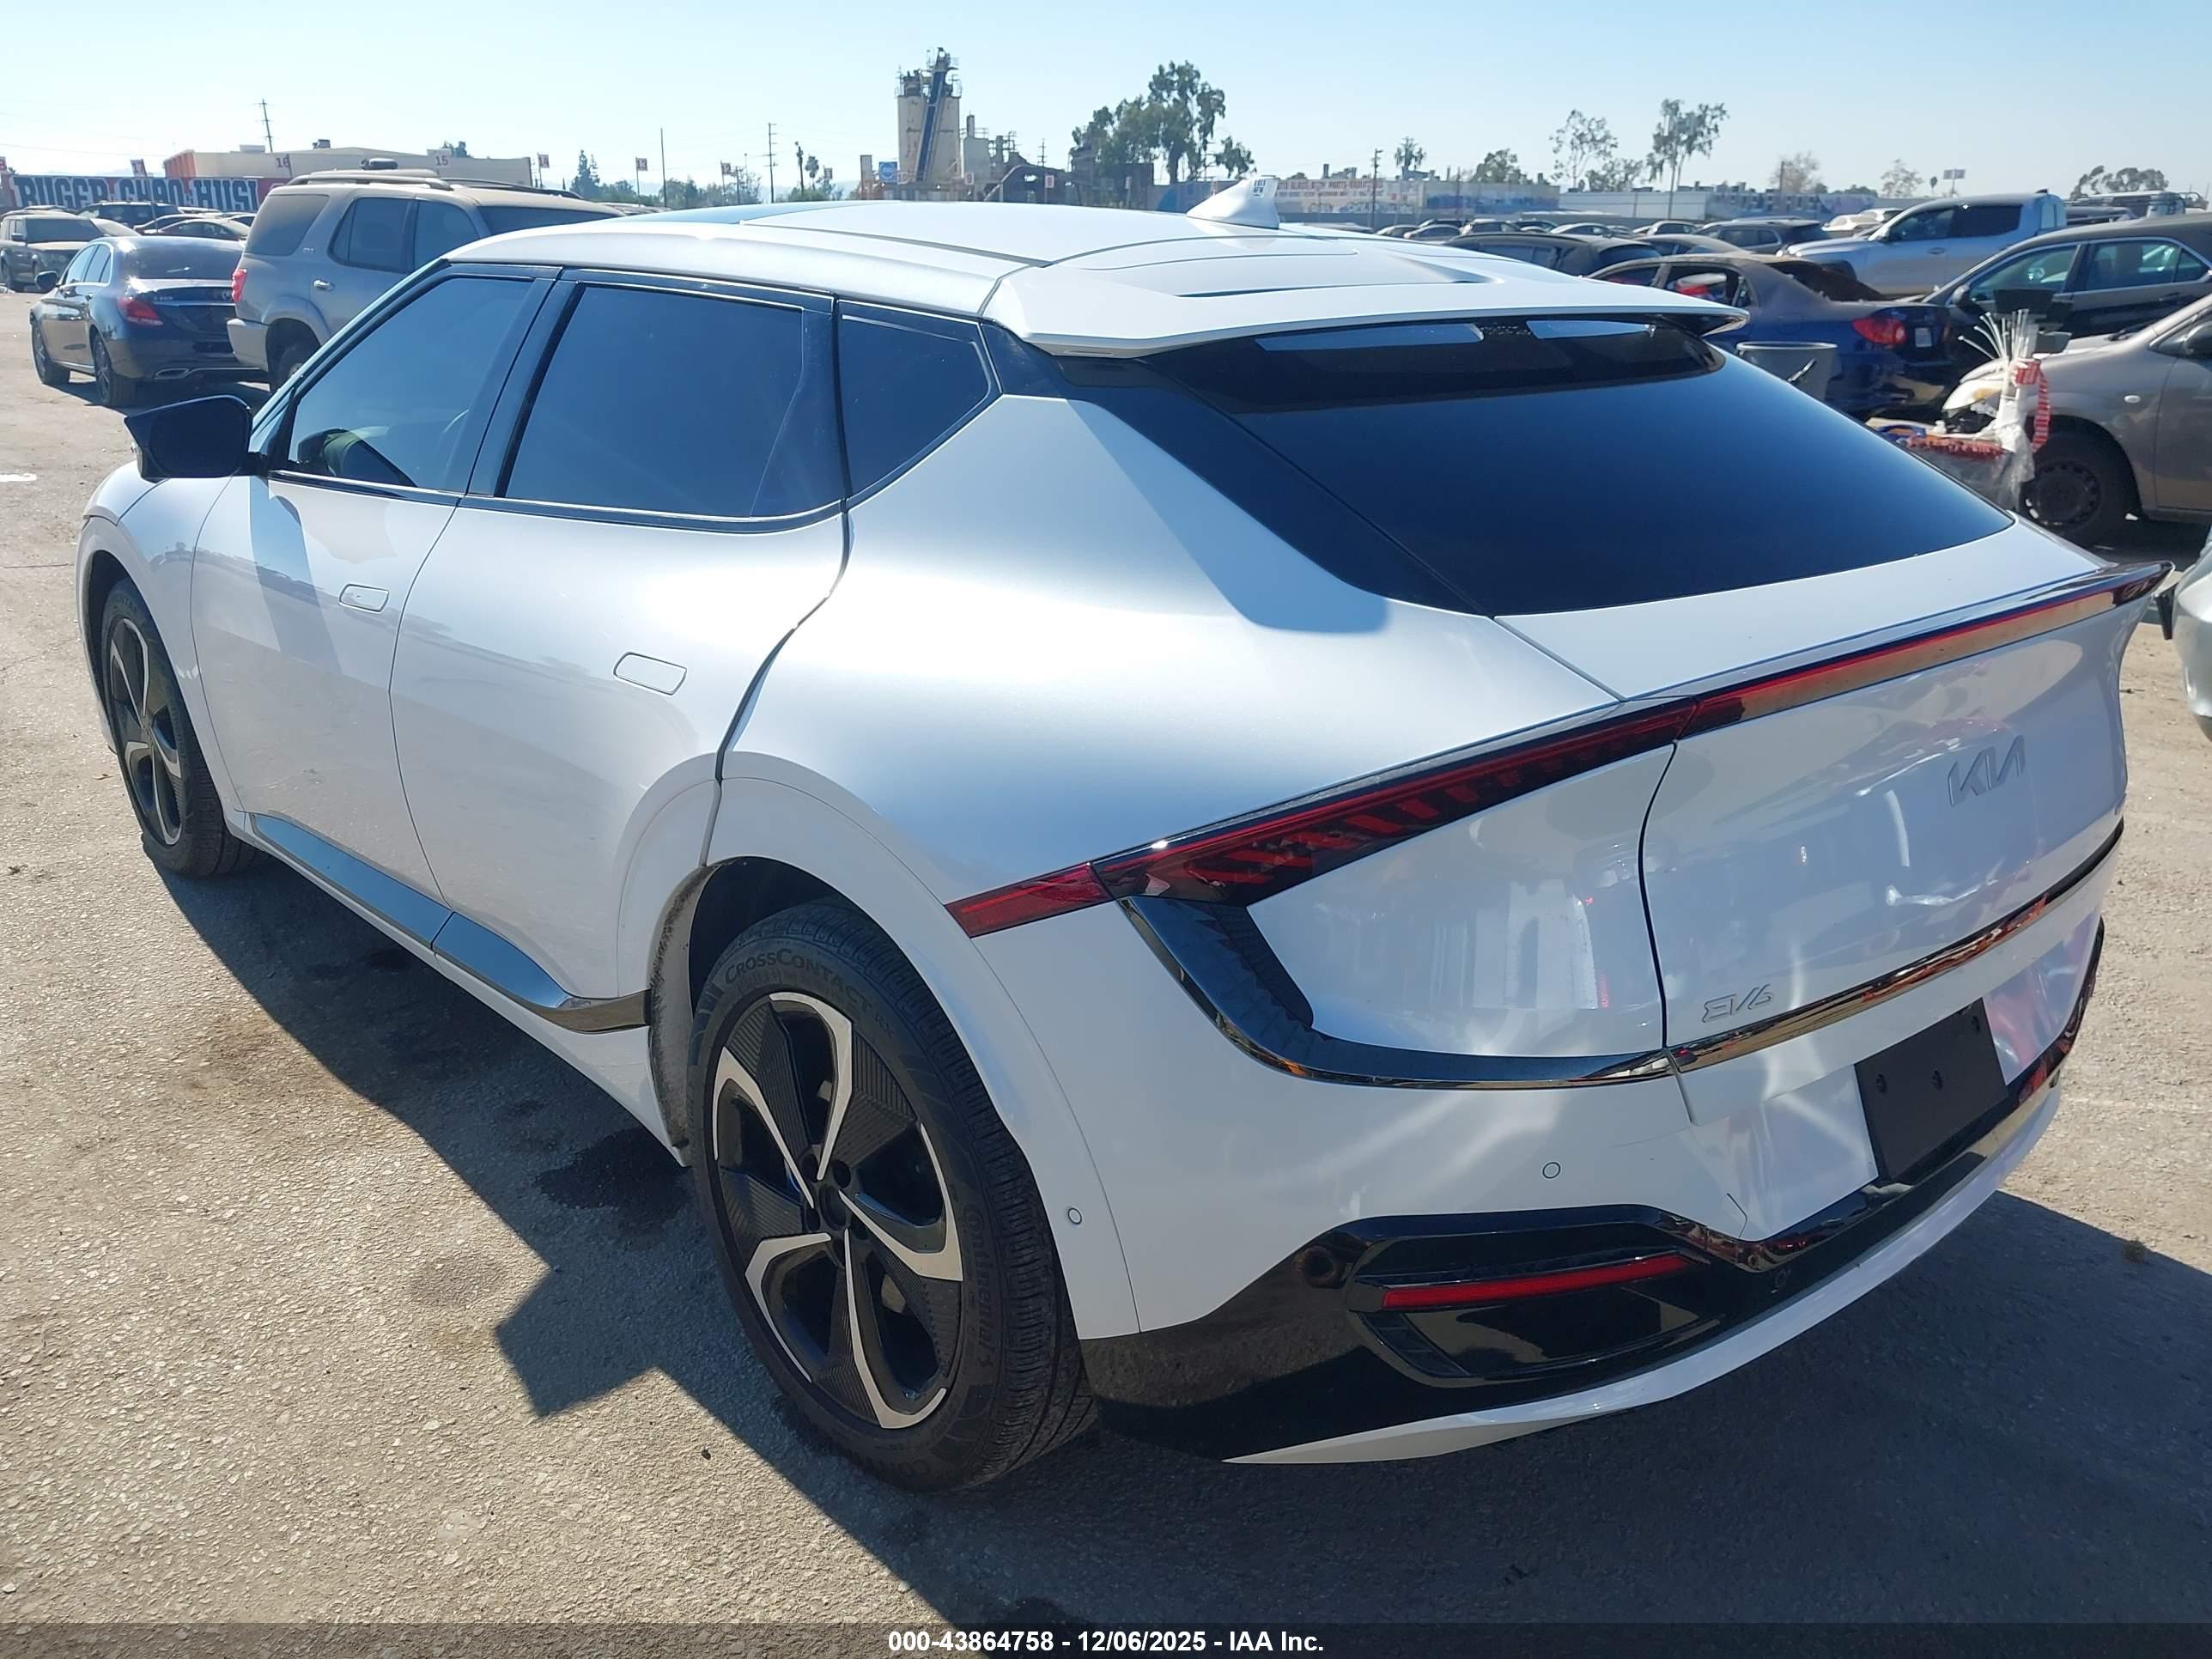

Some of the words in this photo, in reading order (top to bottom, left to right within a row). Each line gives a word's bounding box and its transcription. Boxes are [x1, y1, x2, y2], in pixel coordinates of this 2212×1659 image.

[276, 157, 289, 167] 16
[435, 155, 449, 166] 15
[1701, 983, 1774, 1024] EV6
